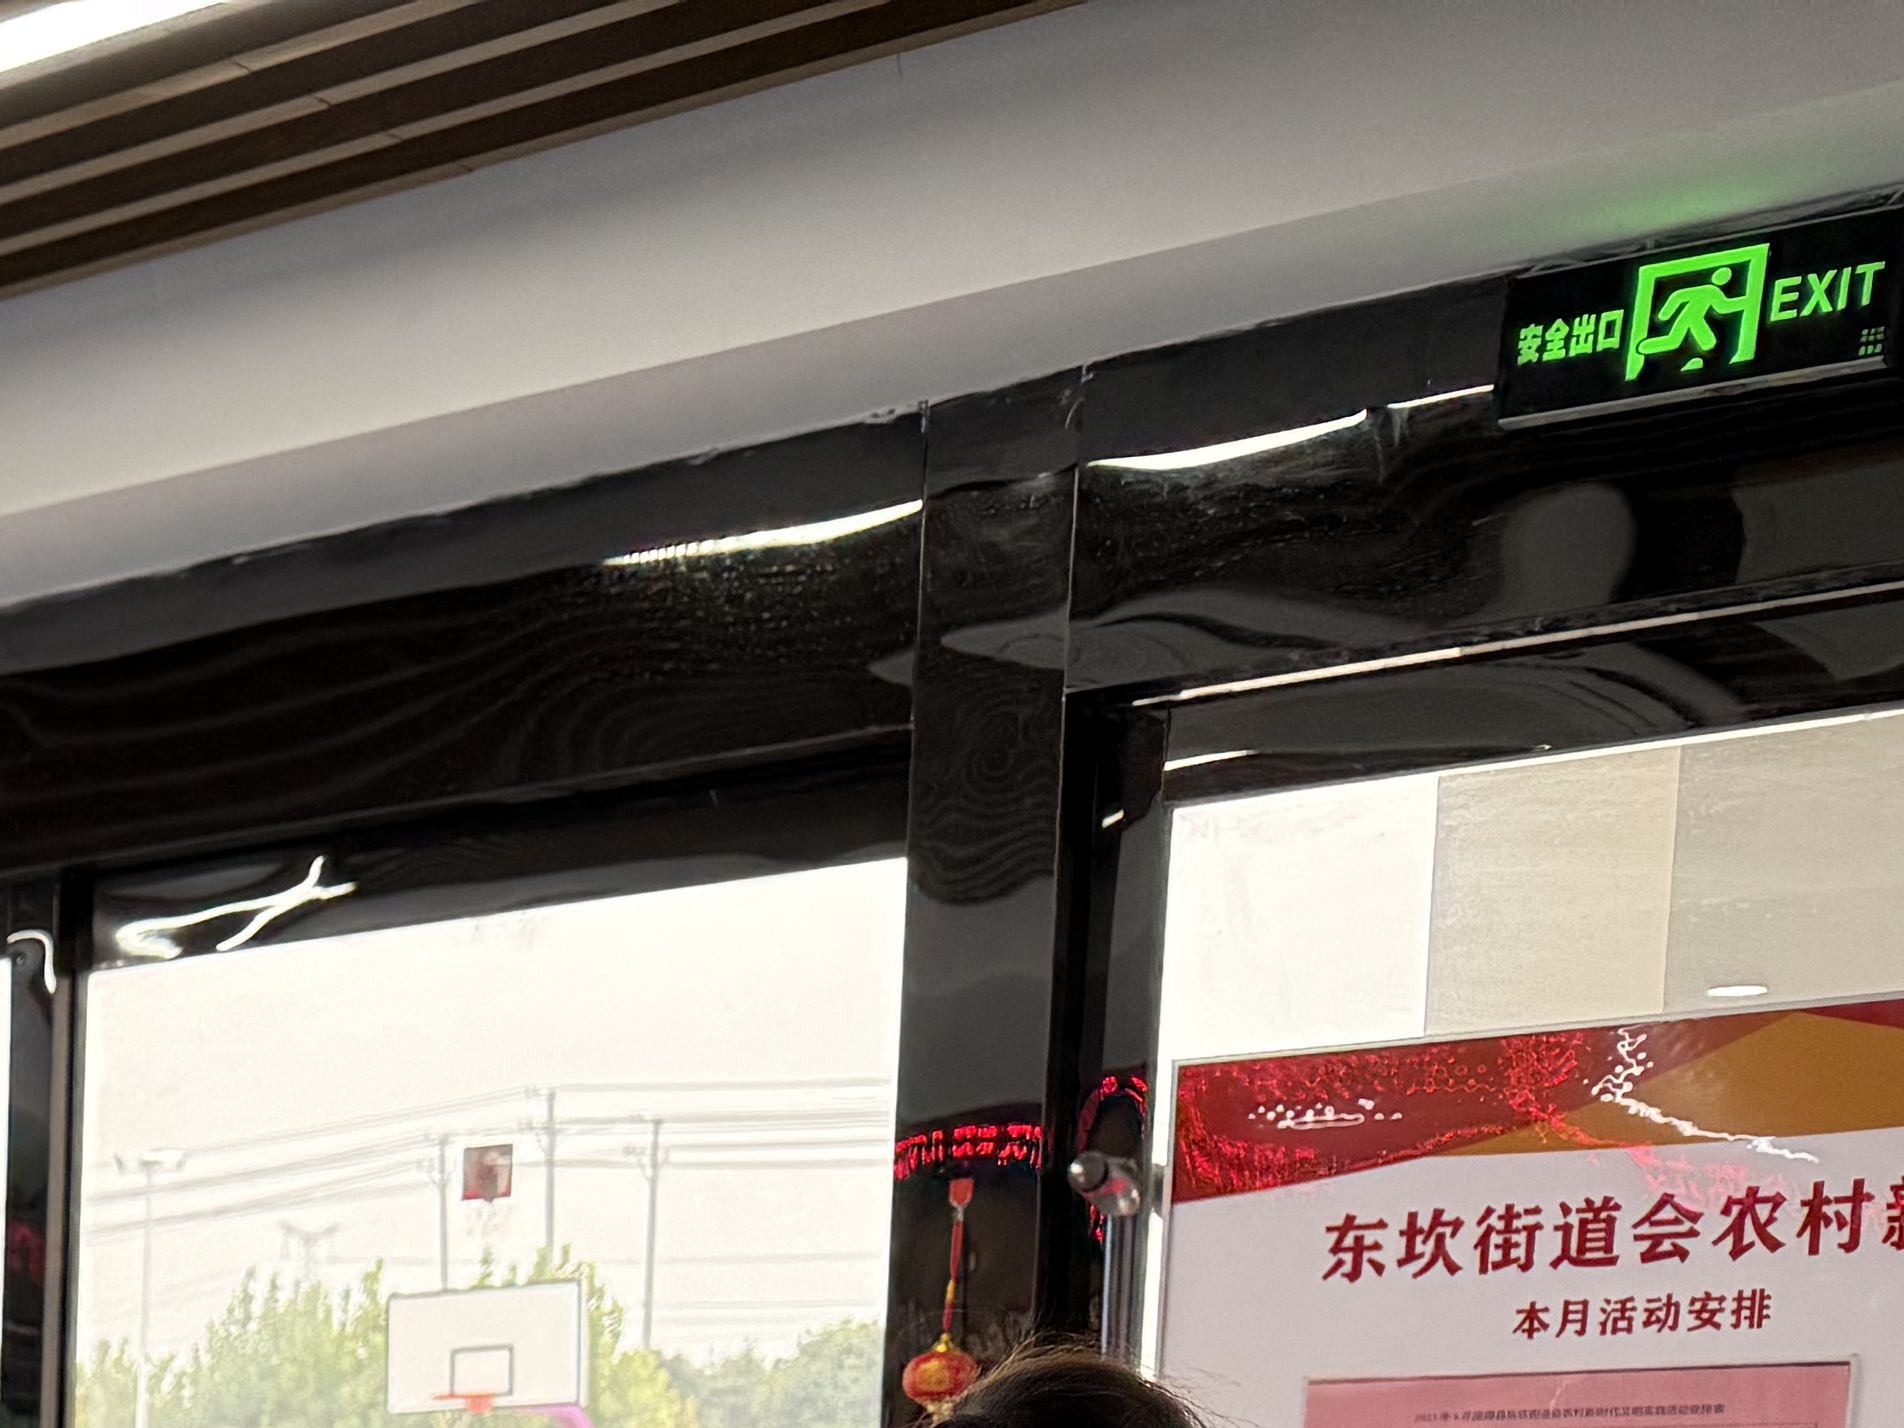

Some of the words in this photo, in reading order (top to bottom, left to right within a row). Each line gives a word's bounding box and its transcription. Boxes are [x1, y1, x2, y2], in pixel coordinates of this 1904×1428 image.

[1769, 260, 1886, 323] EXIT
[1517, 308, 1625, 366] 安全出口
[1512, 1288, 1773, 1340] 本月活动安排
